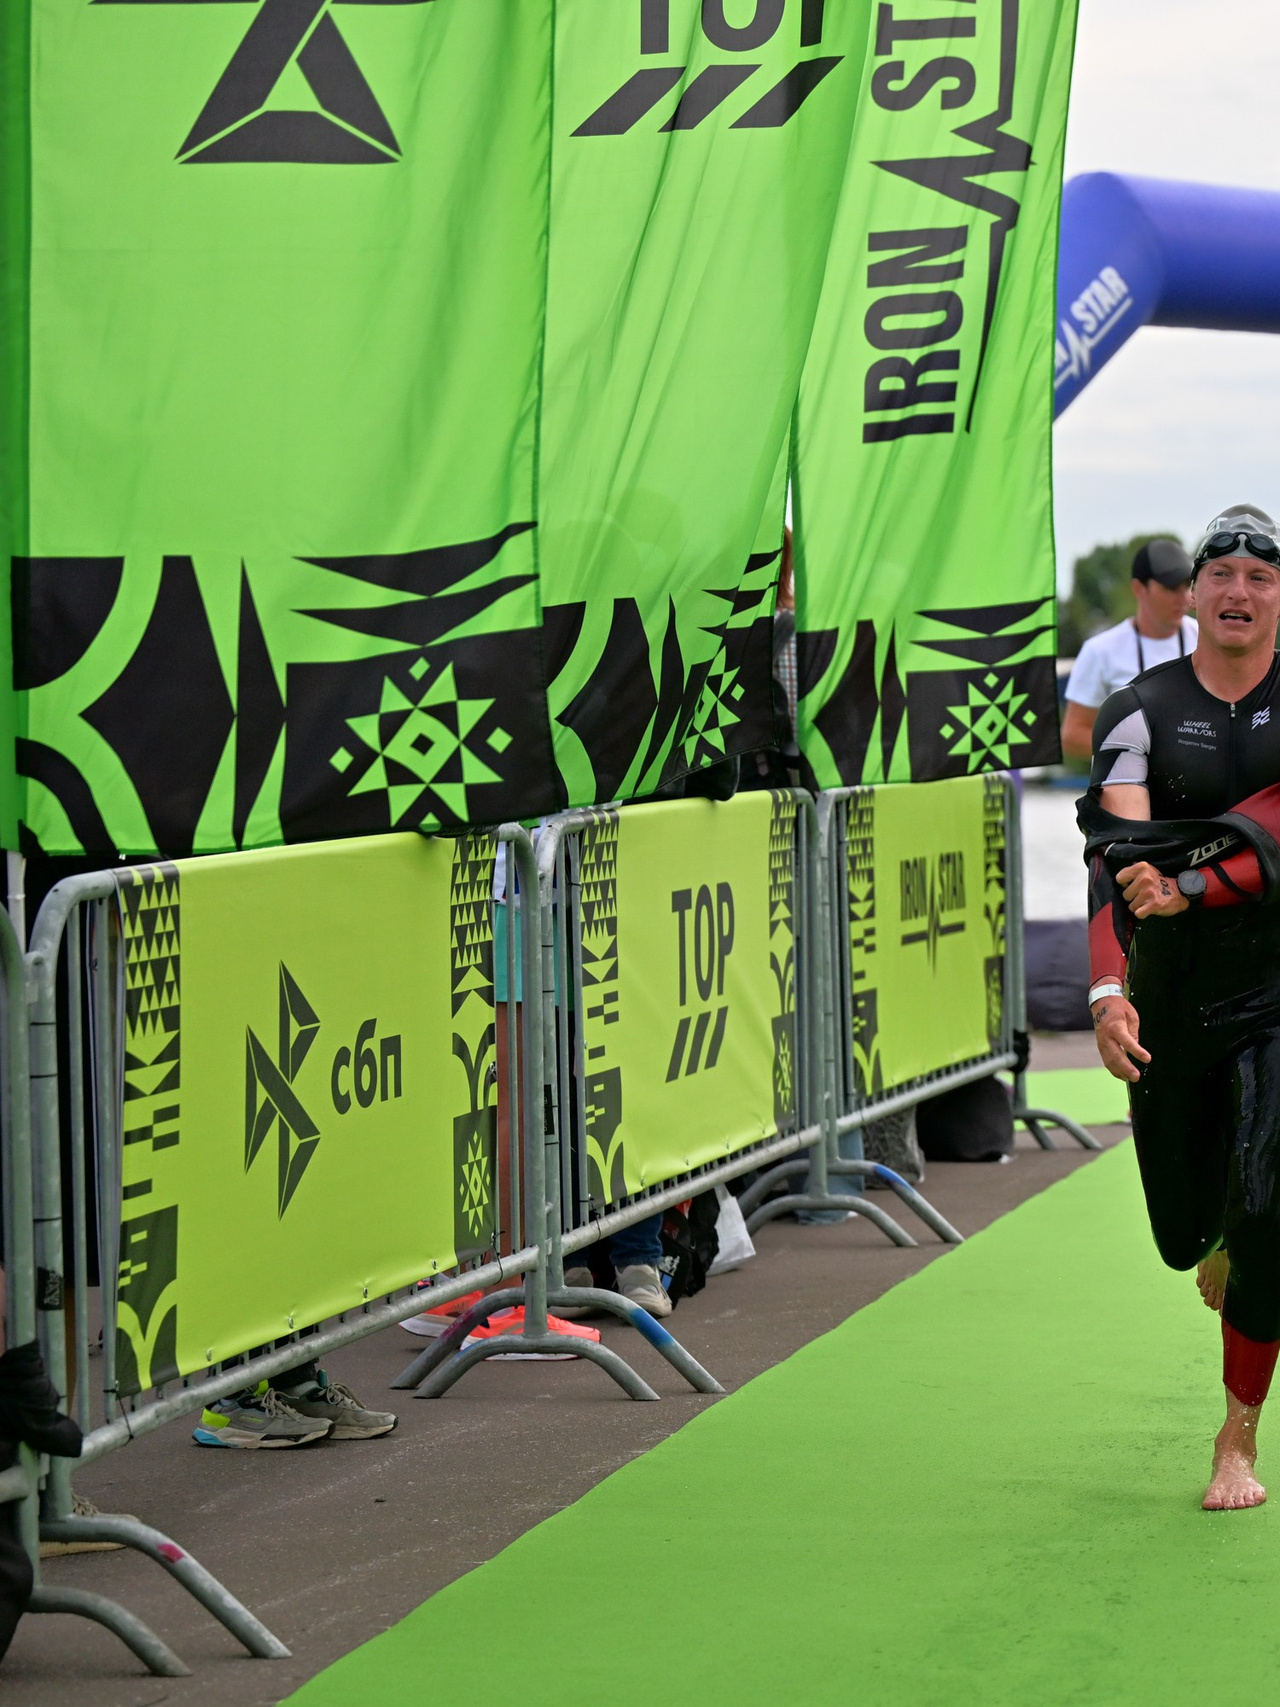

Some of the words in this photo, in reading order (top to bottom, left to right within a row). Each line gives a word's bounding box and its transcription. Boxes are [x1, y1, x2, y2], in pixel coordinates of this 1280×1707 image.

[871, 0, 976, 111] ST
[863, 224, 968, 443] IRON
[1069, 265, 1129, 333] STAR
[1177, 726, 1217, 738] WARRIORS
[1183, 720, 1212, 729] WHEEL
[900, 856, 928, 921] IRON
[938, 850, 966, 913] STAR
[1159, 873, 1172, 896] 04
[671, 881, 735, 1007] TOP
[330, 1017, 402, 1115] сбп
